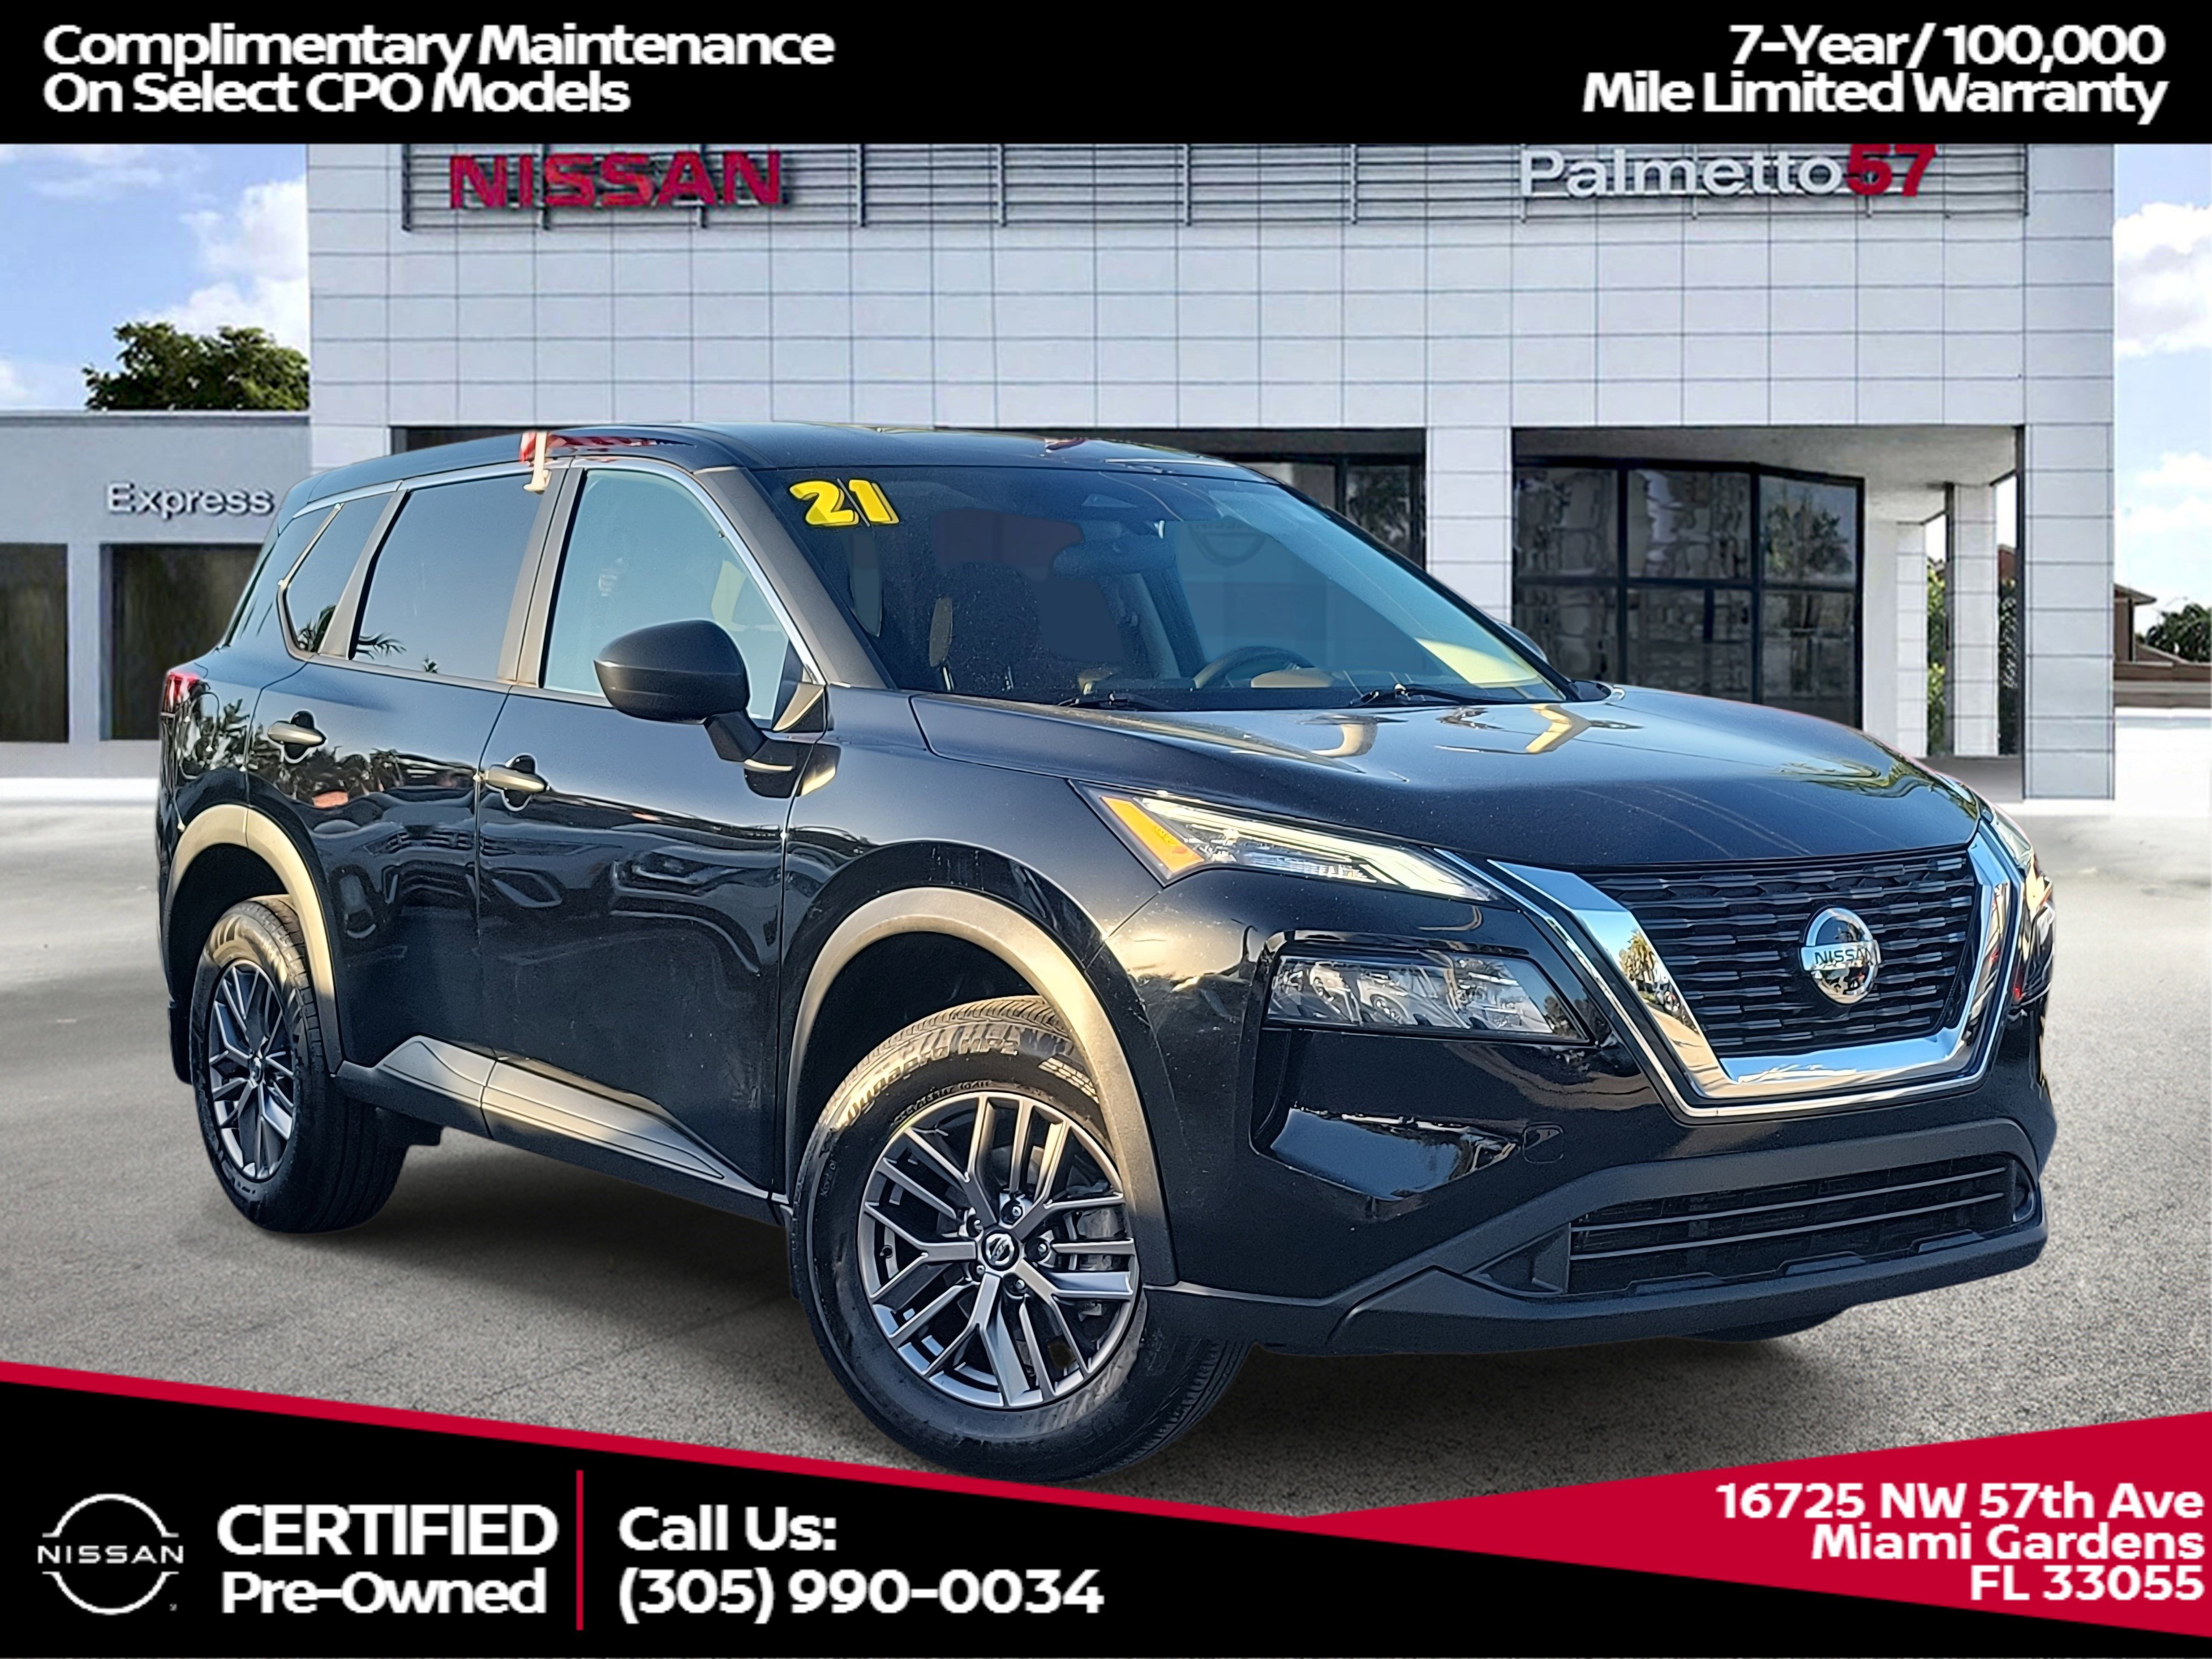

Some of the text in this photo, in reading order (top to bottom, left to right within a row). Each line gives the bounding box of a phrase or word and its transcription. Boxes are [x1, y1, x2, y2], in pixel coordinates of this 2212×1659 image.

[450, 149, 782, 209] NISSAN
[108, 483, 275, 520] Express
[788, 479, 901, 527] 21
[1814, 947, 1879, 966] NISSAN
